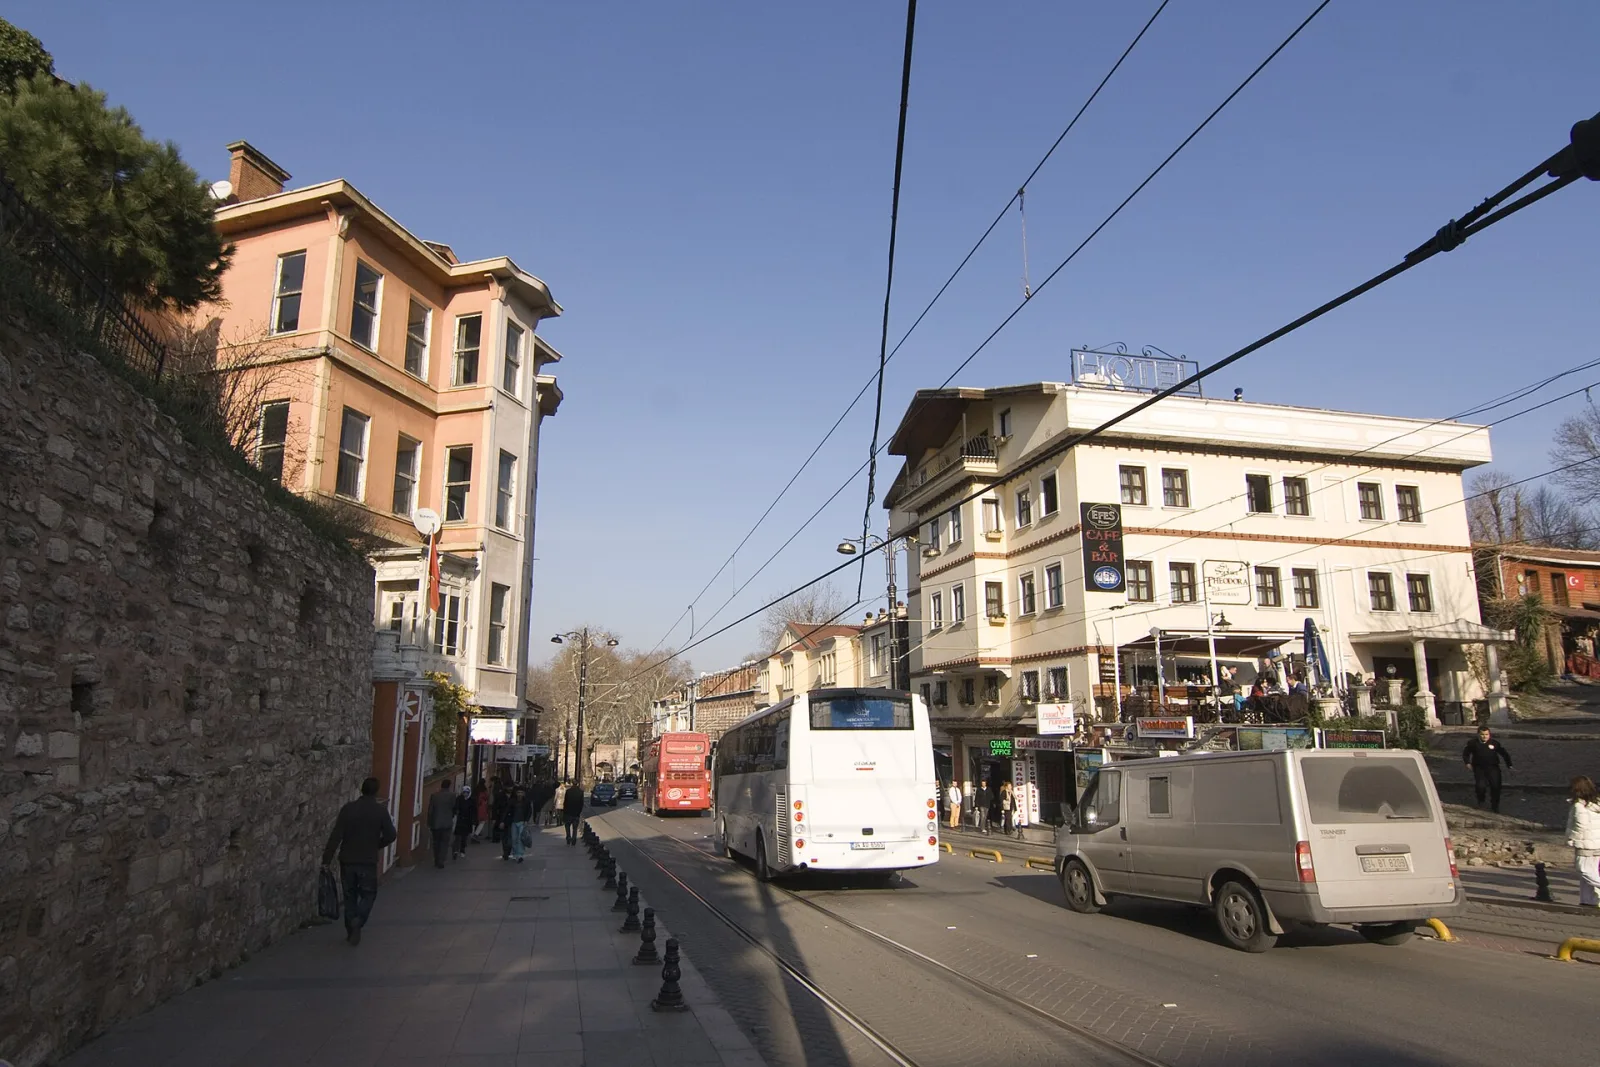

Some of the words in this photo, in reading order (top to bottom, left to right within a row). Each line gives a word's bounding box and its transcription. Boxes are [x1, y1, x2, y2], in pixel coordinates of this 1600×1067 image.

[1077, 352, 1199, 393] HOTEL
[1091, 510, 1116, 520] EFES
[1085, 529, 1121, 541] CAFE
[1098, 541, 1110, 552] &
[1091, 551, 1118, 562] BAR
[1204, 576, 1248, 587] THEODORA
[990, 740, 1012, 748] CHANGE
[1017, 740, 1041, 748] CHANGE
[1042, 740, 1065, 749] OFFICE
[991, 748, 1011, 756] OFFICE
[1029, 756, 1035, 765] NO
[1015, 762, 1023, 791] CHANGE
[1029, 766, 1037, 812] COMMISSION
[1016, 794, 1025, 824] OFFICE
